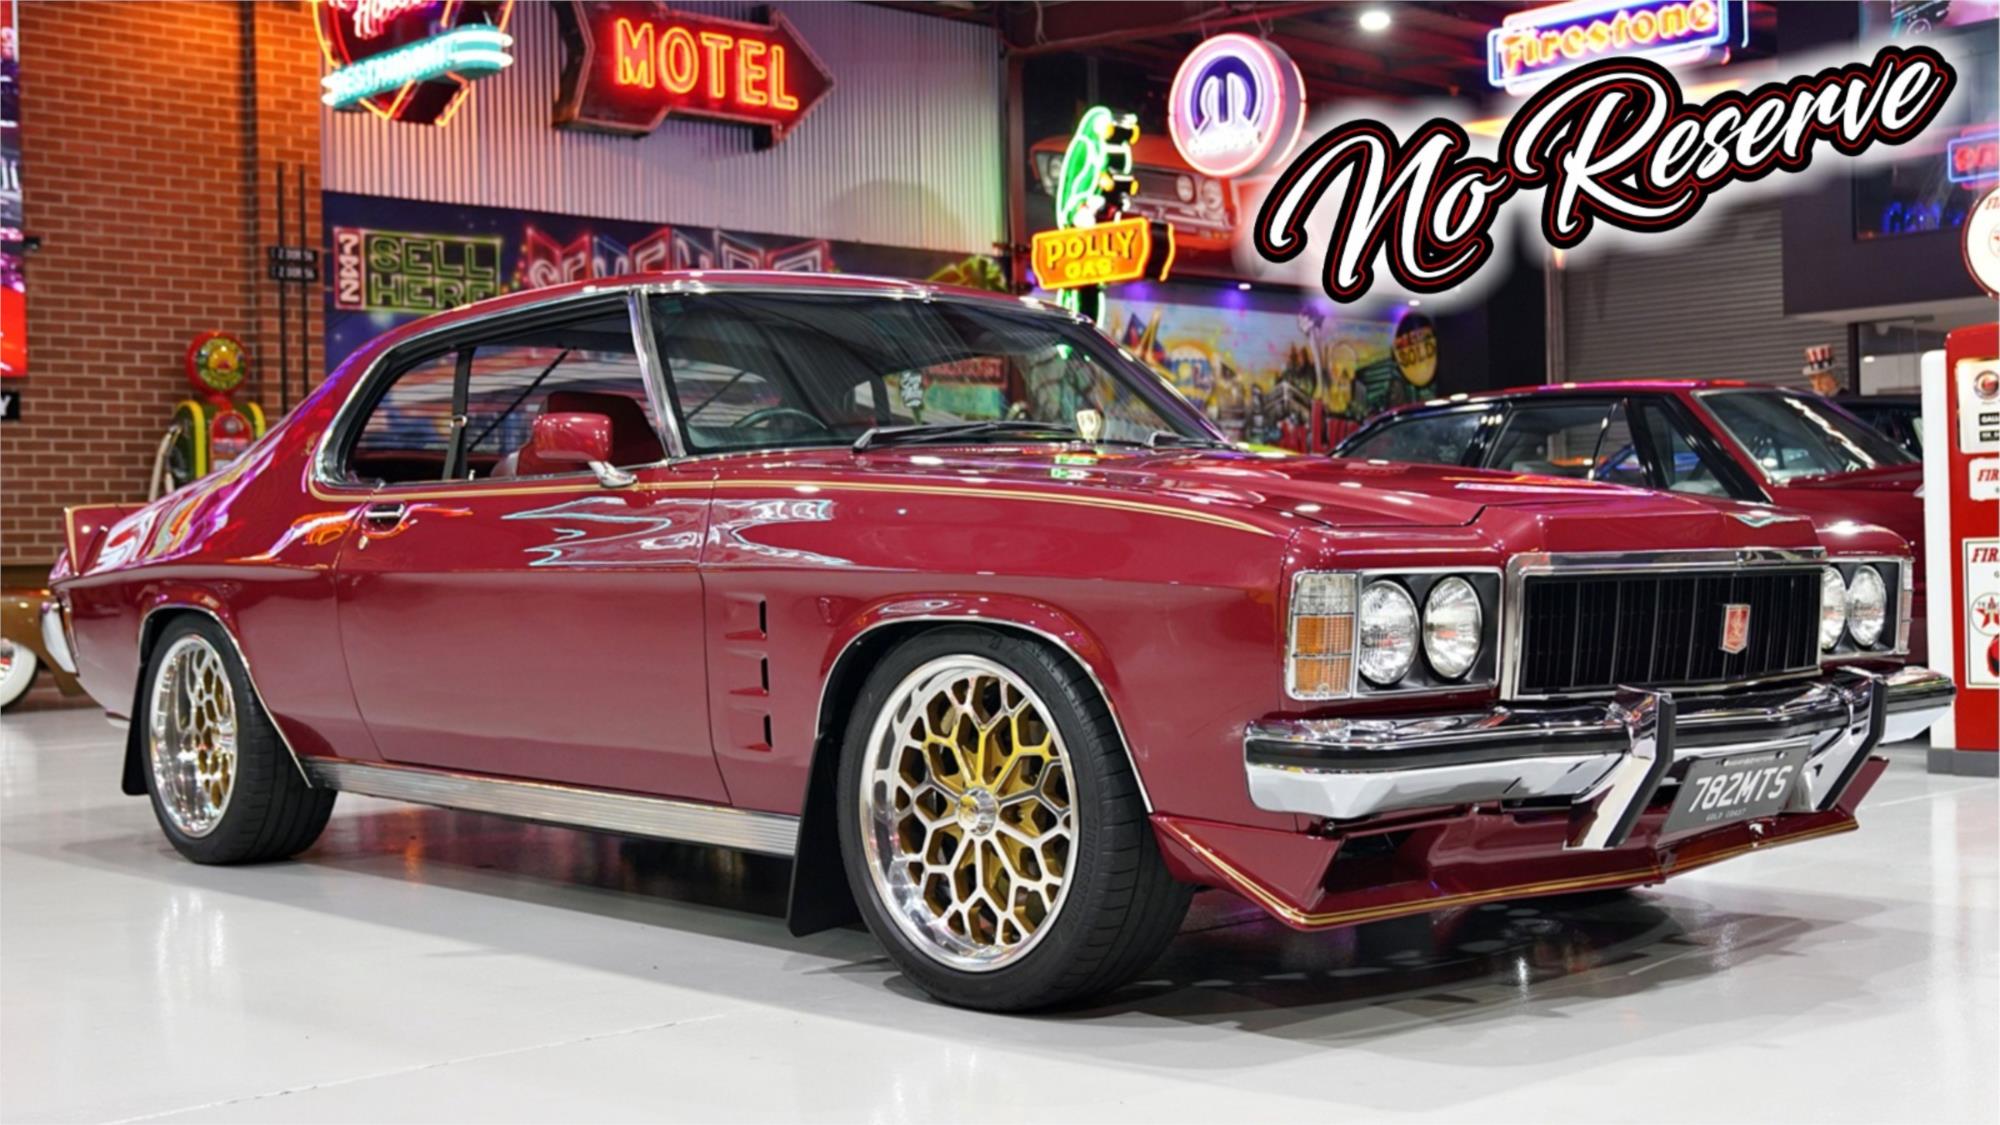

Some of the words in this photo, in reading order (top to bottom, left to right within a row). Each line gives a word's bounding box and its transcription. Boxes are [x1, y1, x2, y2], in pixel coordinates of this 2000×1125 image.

[1502, 1, 1717, 74] Firestone
[616, 18, 799, 111] MOTEL
[370, 237, 493, 278] SELL
[1044, 230, 1137, 269] POLLY
[1064, 258, 1112, 280] GAS
[1688, 765, 1793, 813] 782MTS
